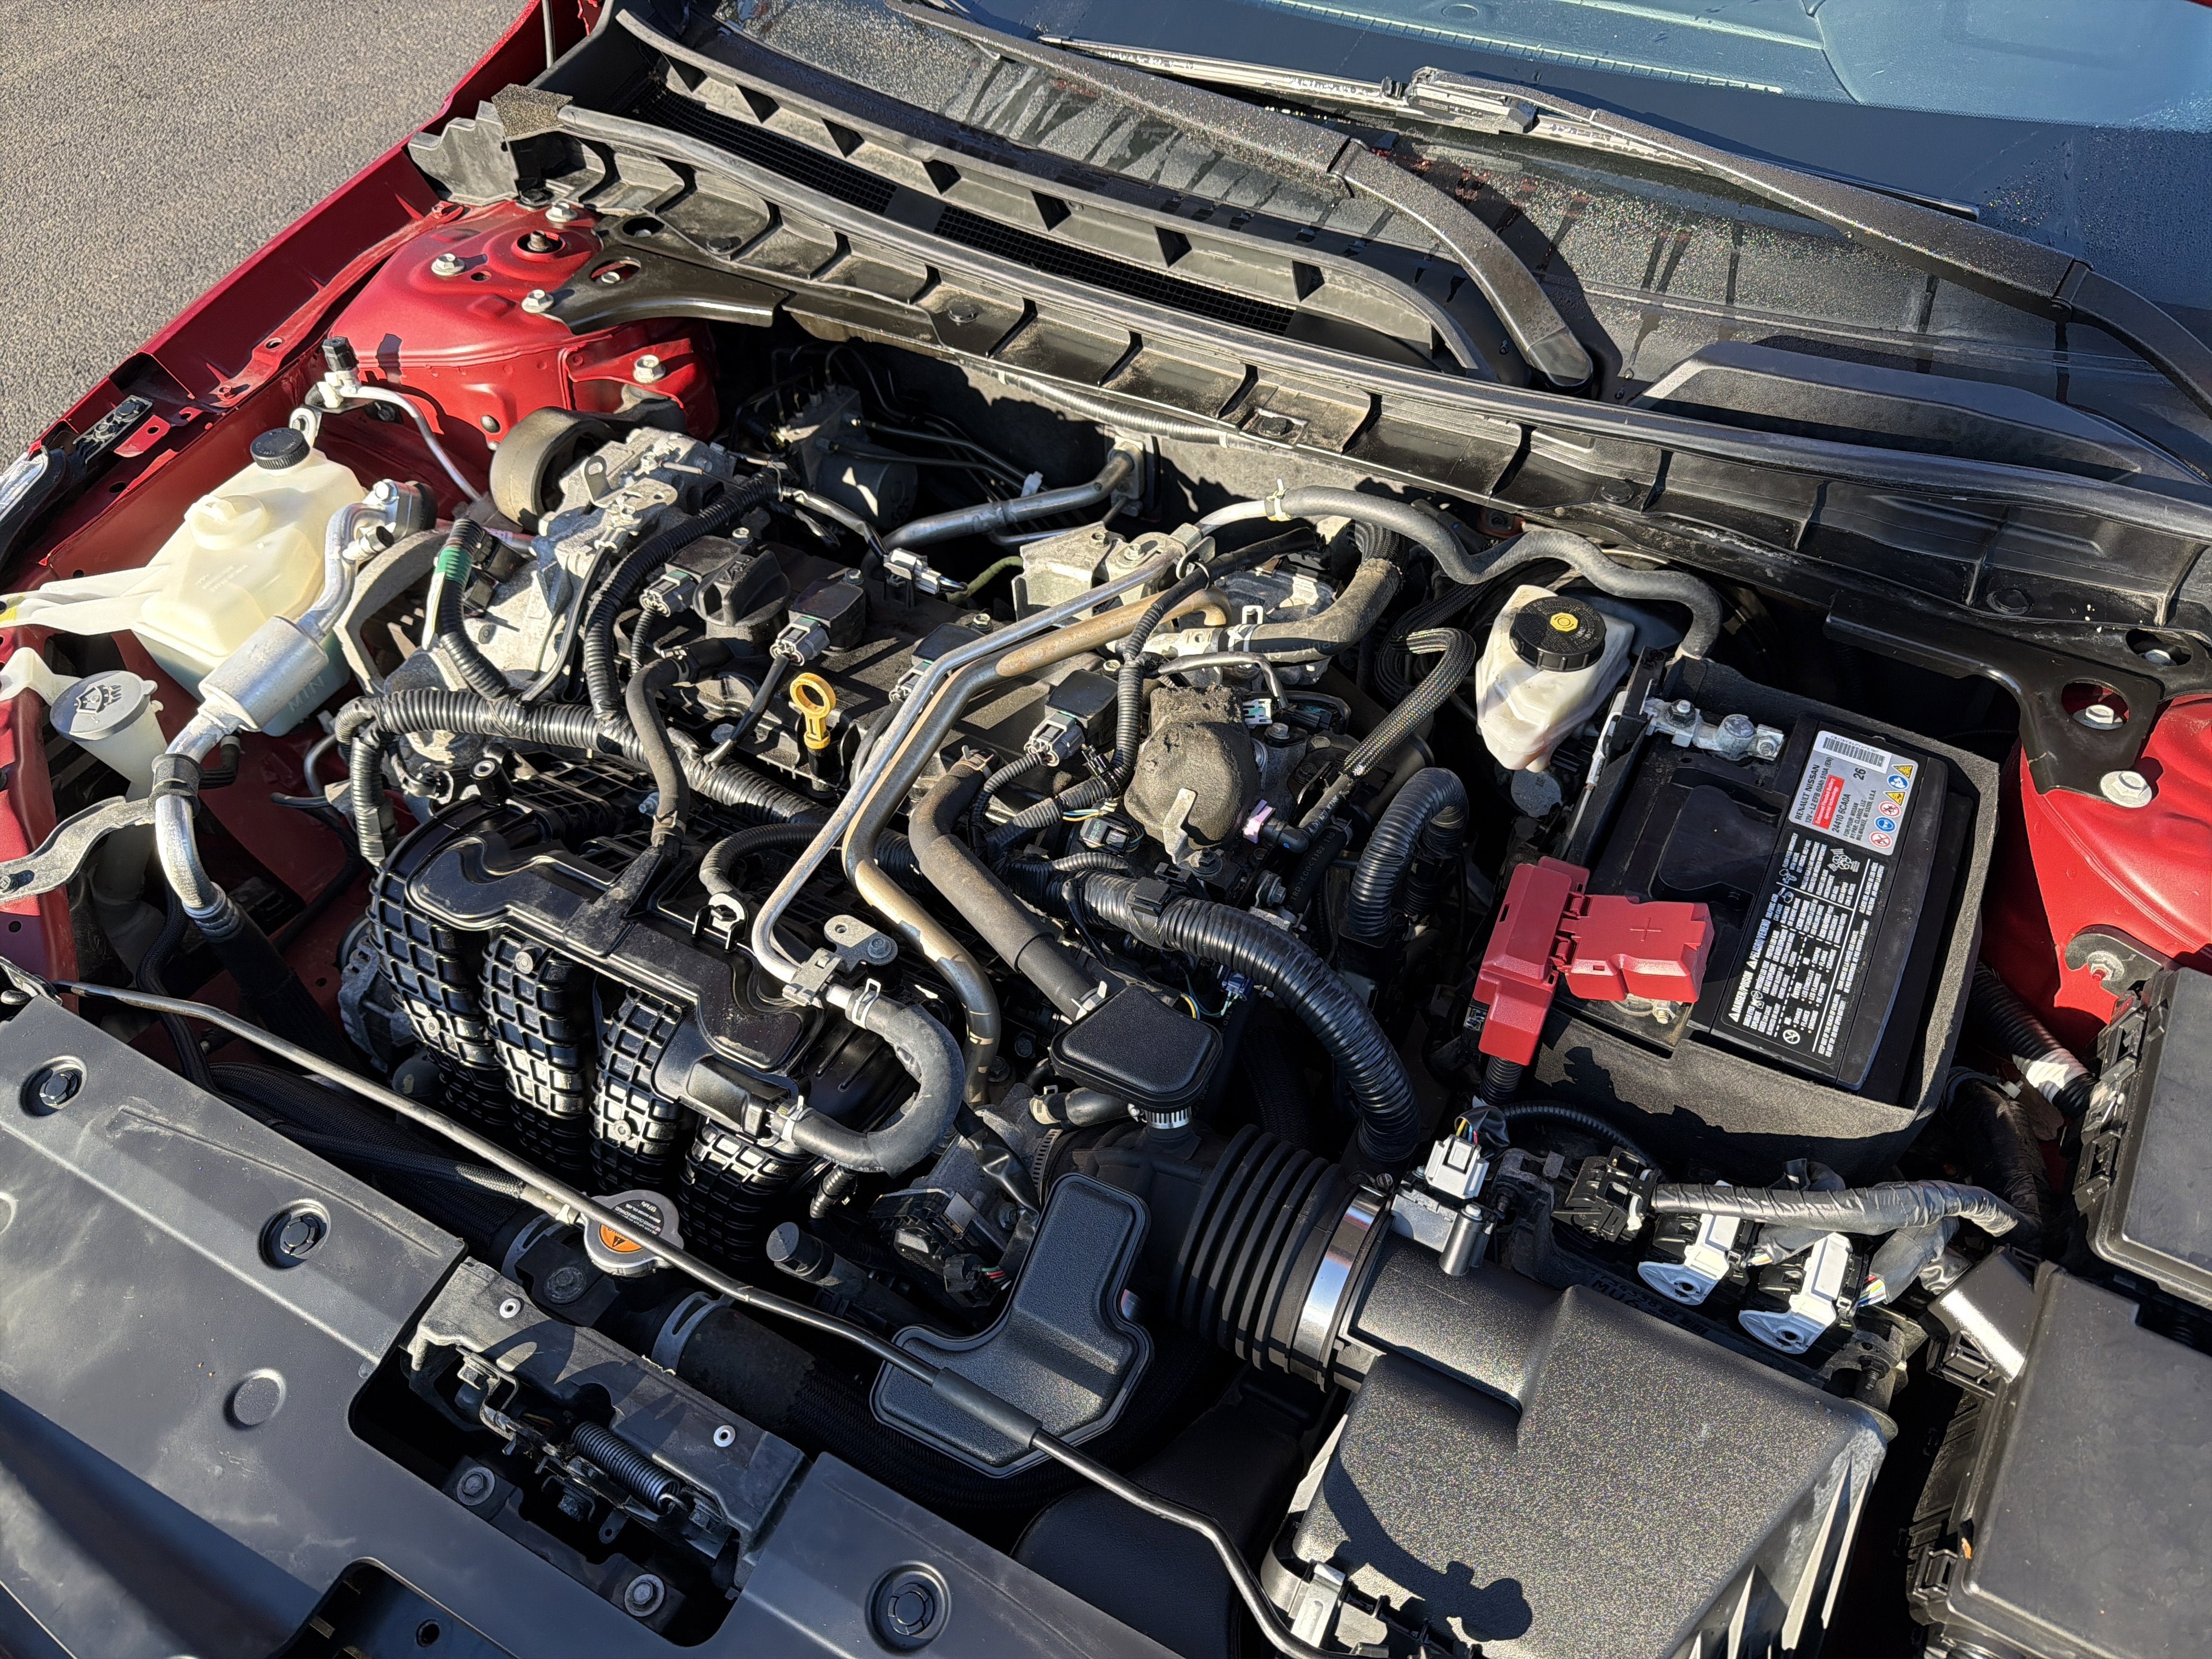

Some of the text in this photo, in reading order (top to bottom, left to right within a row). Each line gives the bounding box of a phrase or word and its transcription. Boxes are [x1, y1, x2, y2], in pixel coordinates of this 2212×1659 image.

[288, 675, 325, 712] MIN
[1816, 779, 1824, 792] 60Ah
[1820, 768, 1829, 779] 510A
[1825, 757, 1833, 768] (EN)
[1853, 767, 1866, 780] 26
[1795, 764, 1819, 820] RENAULT NISSAN
[1815, 778, 1835, 823] Enhanced Flooded Battery
[1823, 786, 1838, 820] special technology
[1850, 802, 1858, 816] NISSAN
[1832, 814, 1843, 832] 24410
[1324, 832, 1335, 843] TRD
[1812, 947, 1821, 963] CHISPAS
[1819, 950, 1827, 966] FLAMAS
[1731, 918, 1770, 1013] DANGER/POISON PELIGRO/VENENO
[1784, 1017, 1791, 1025] NO
[1793, 1007, 1802, 1024] SPARKS
[1801, 1010, 1810, 1026] FLAMES
[1808, 1010, 1818, 1029] SMOKING
